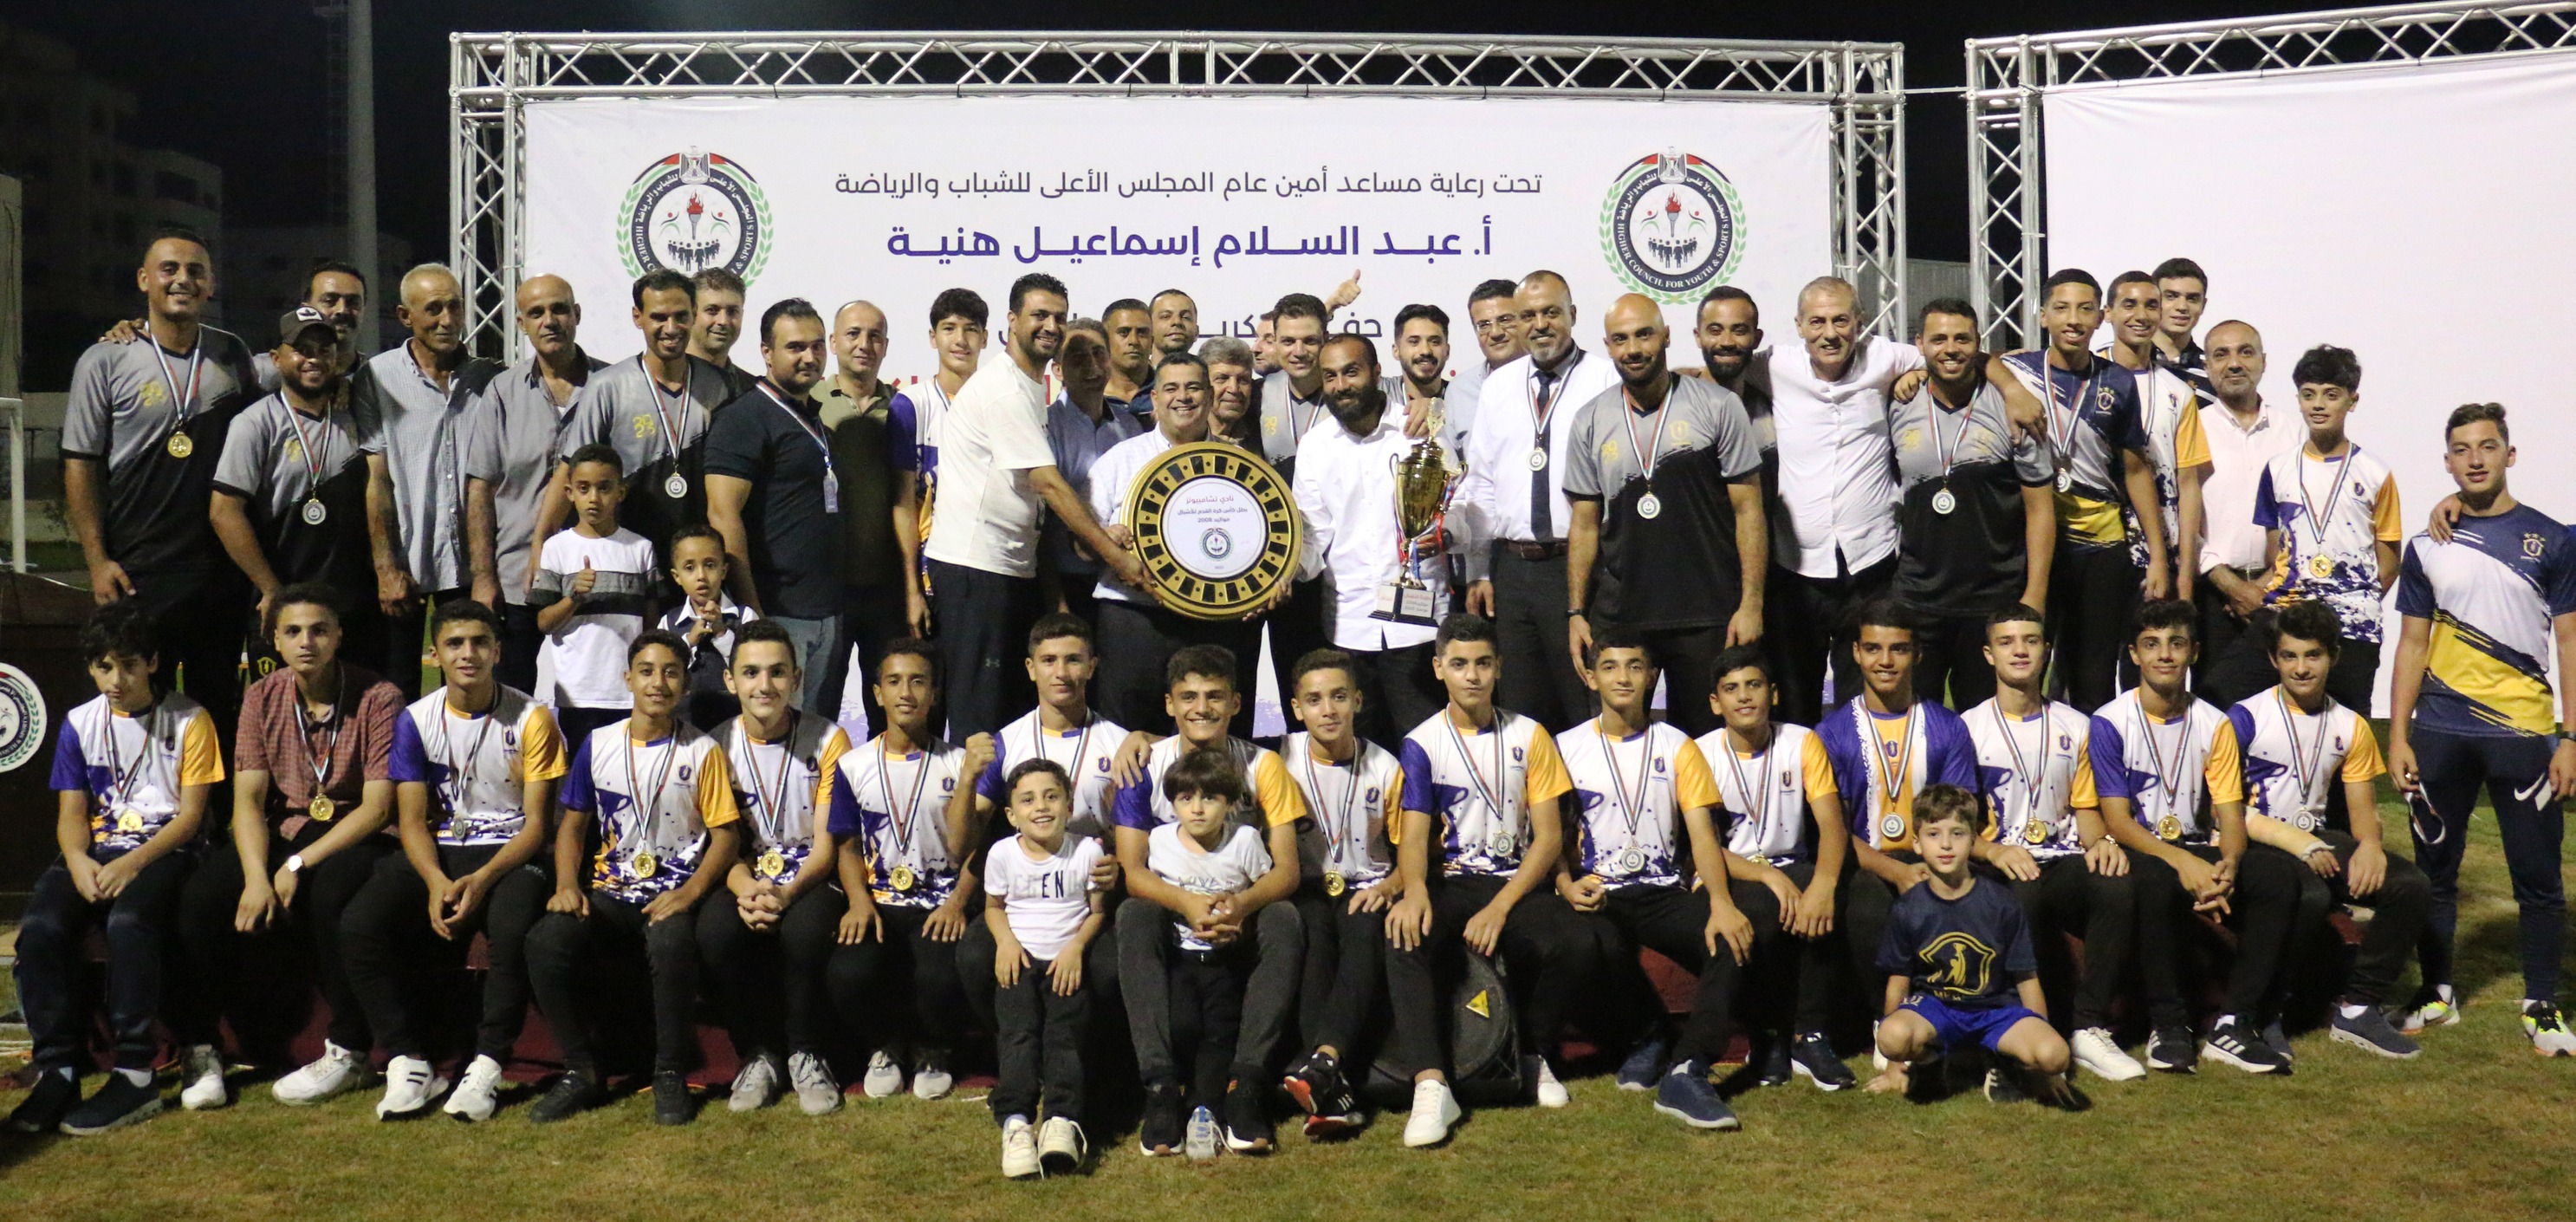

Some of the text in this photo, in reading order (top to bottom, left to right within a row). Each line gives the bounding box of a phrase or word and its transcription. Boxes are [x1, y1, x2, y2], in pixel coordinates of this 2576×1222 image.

[835, 165, 1542, 201] تحت رعاية مساعد أمين عام المجلس الأعلى للشباب والرياضة
[635, 225, 651, 264] HIGHER
[740, 224, 754, 260] SPORTS
[887, 226, 1001, 265] هنية
[1014, 225, 1201, 268] إسماعيل
[1213, 225, 1360, 270] السلام
[1372, 231, 1462, 264] عبد
[1618, 224, 1632, 260] HIGHER
[1628, 259, 1664, 287] COUNCIL
[1665, 280, 1684, 289] FOR
[1684, 266, 1714, 287] YOUTH
[1716, 223, 1729, 259] SPORTS
[1328, 311, 1382, 337] حف
